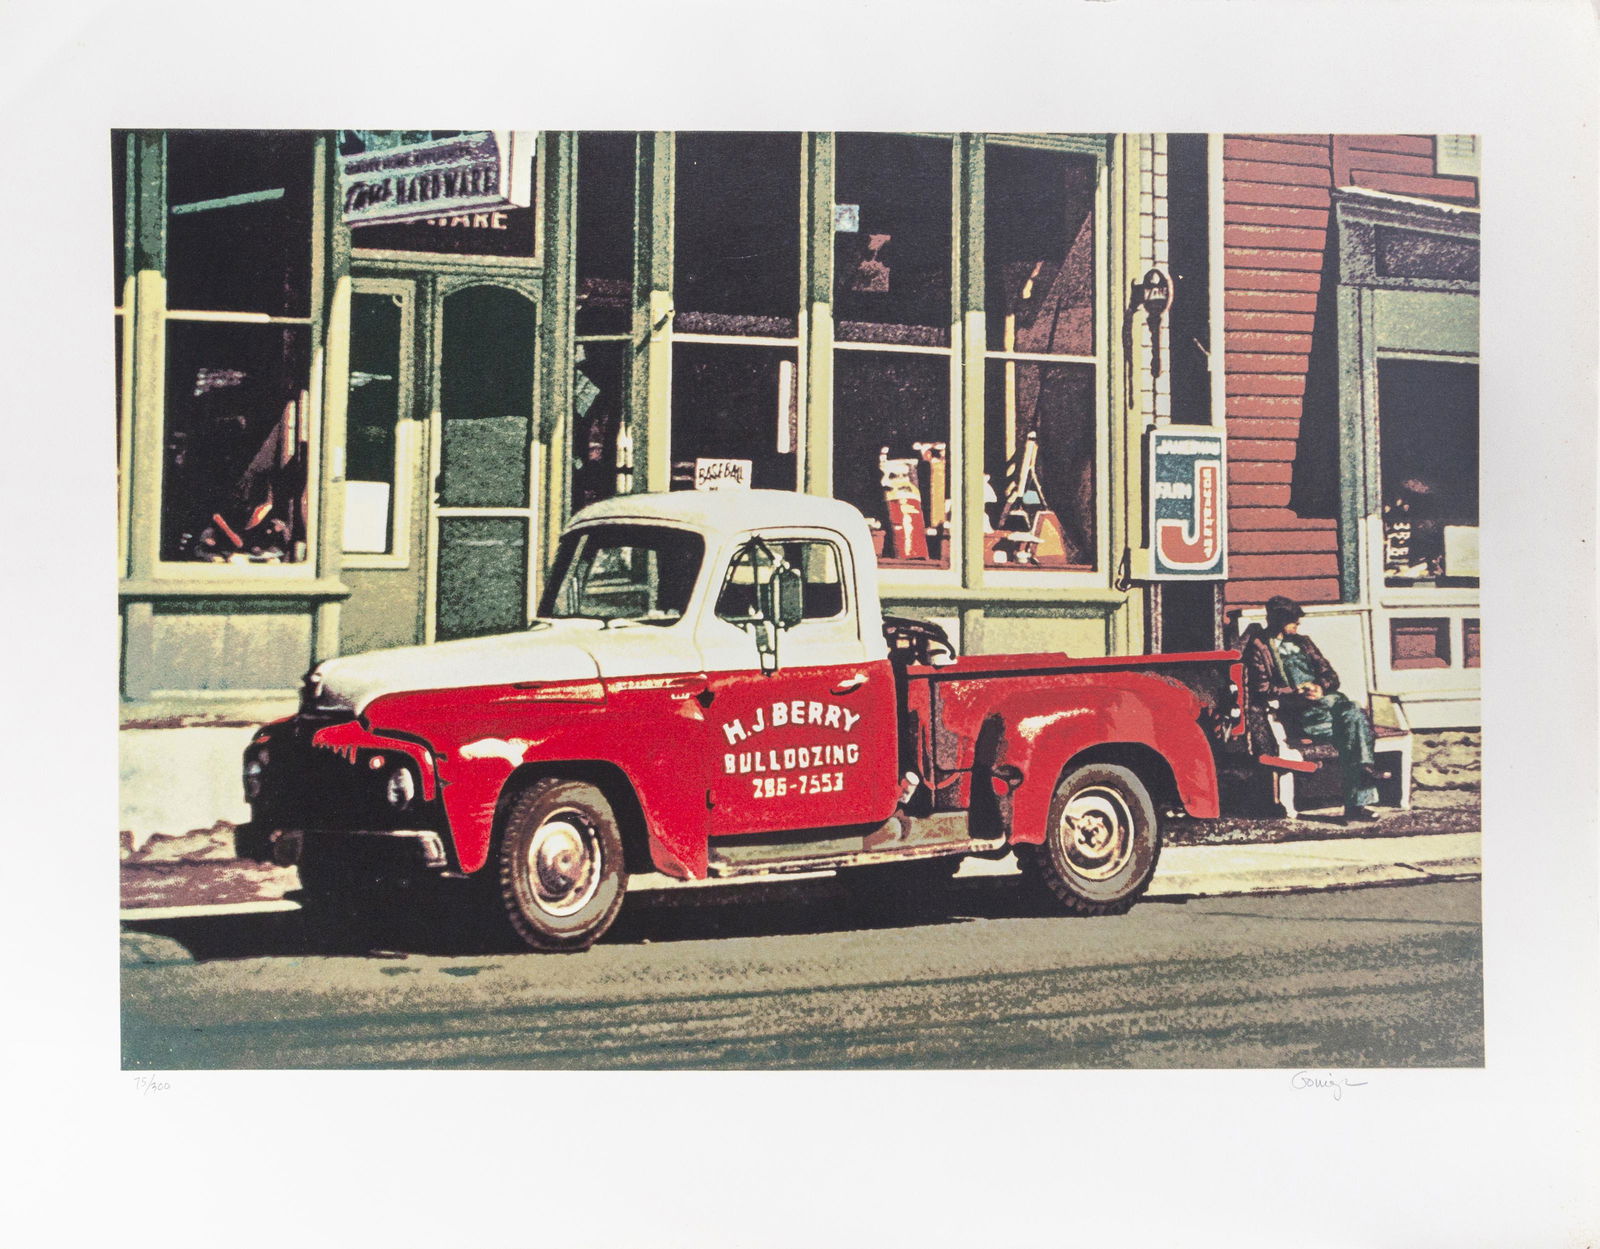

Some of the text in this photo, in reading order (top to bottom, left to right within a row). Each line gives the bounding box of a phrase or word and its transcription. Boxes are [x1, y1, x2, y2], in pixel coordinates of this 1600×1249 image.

[772, 700, 860, 732] BERRY
[724, 743, 859, 774] BULLDOZING
[752, 772, 844, 799] 286-7553
